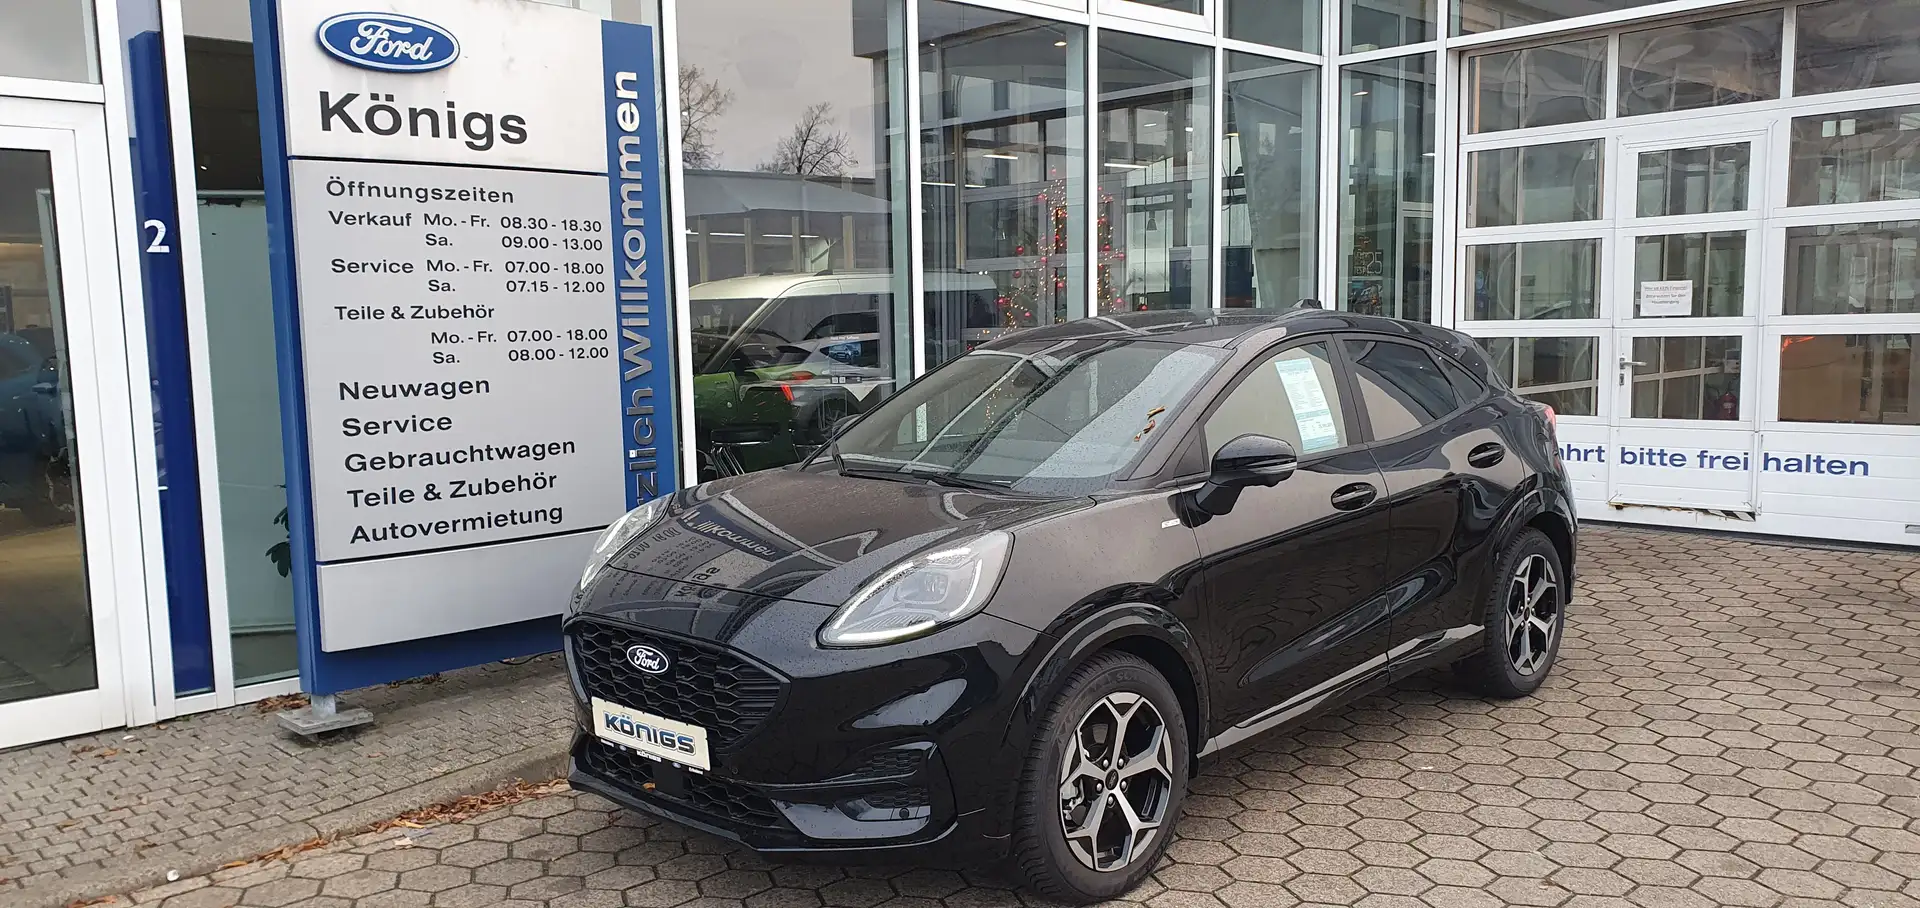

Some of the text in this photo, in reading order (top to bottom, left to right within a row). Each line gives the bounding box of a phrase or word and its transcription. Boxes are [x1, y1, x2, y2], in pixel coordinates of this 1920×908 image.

[319, 90, 528, 152] Königs
[326, 176, 514, 203] Öffnungszeiten
[327, 210, 412, 227] Verkauf
[423, 213, 457, 227] Mo.
[470, 214, 490, 228] Fr.
[500, 216, 548, 231] 08.30
[561, 219, 602, 233] 18.30
[614, 70, 653, 382] Willkommen
[143, 219, 170, 253] 2
[425, 233, 453, 247] Sa.
[501, 235, 550, 250] 09.00
[562, 238, 603, 251] 13.00
[331, 258, 414, 274] Service
[426, 259, 460, 273] Mo.
[473, 260, 493, 273] Fr.
[504, 260, 551, 274] 07.00
[563, 262, 604, 275] 18.00
[428, 279, 456, 292] Sa.
[506, 280, 549, 293] 07.15
[563, 281, 605, 293] 12.00
[333, 304, 495, 321] Teile & Zubehör
[431, 331, 464, 344] Mo.
[477, 330, 497, 343] Fr.
[507, 329, 553, 343] 07.00
[566, 328, 608, 341] 18.00
[432, 351, 460, 365] Sa.
[508, 348, 556, 362] 08.00
[568, 346, 609, 360] 12.00
[339, 379, 490, 401] Neuwagen
[342, 414, 453, 437] Service
[344, 440, 576, 473] Gebrauchtwagen
[626, 387, 659, 506] zlich
[1620, 446, 1687, 468] bitte
[1696, 450, 1749, 471] frei
[1762, 452, 1870, 477] halten
[346, 471, 558, 508] Teile & Zubehör
[349, 506, 564, 544] Autovermietung
[603, 711, 697, 756] KÖNIGS
